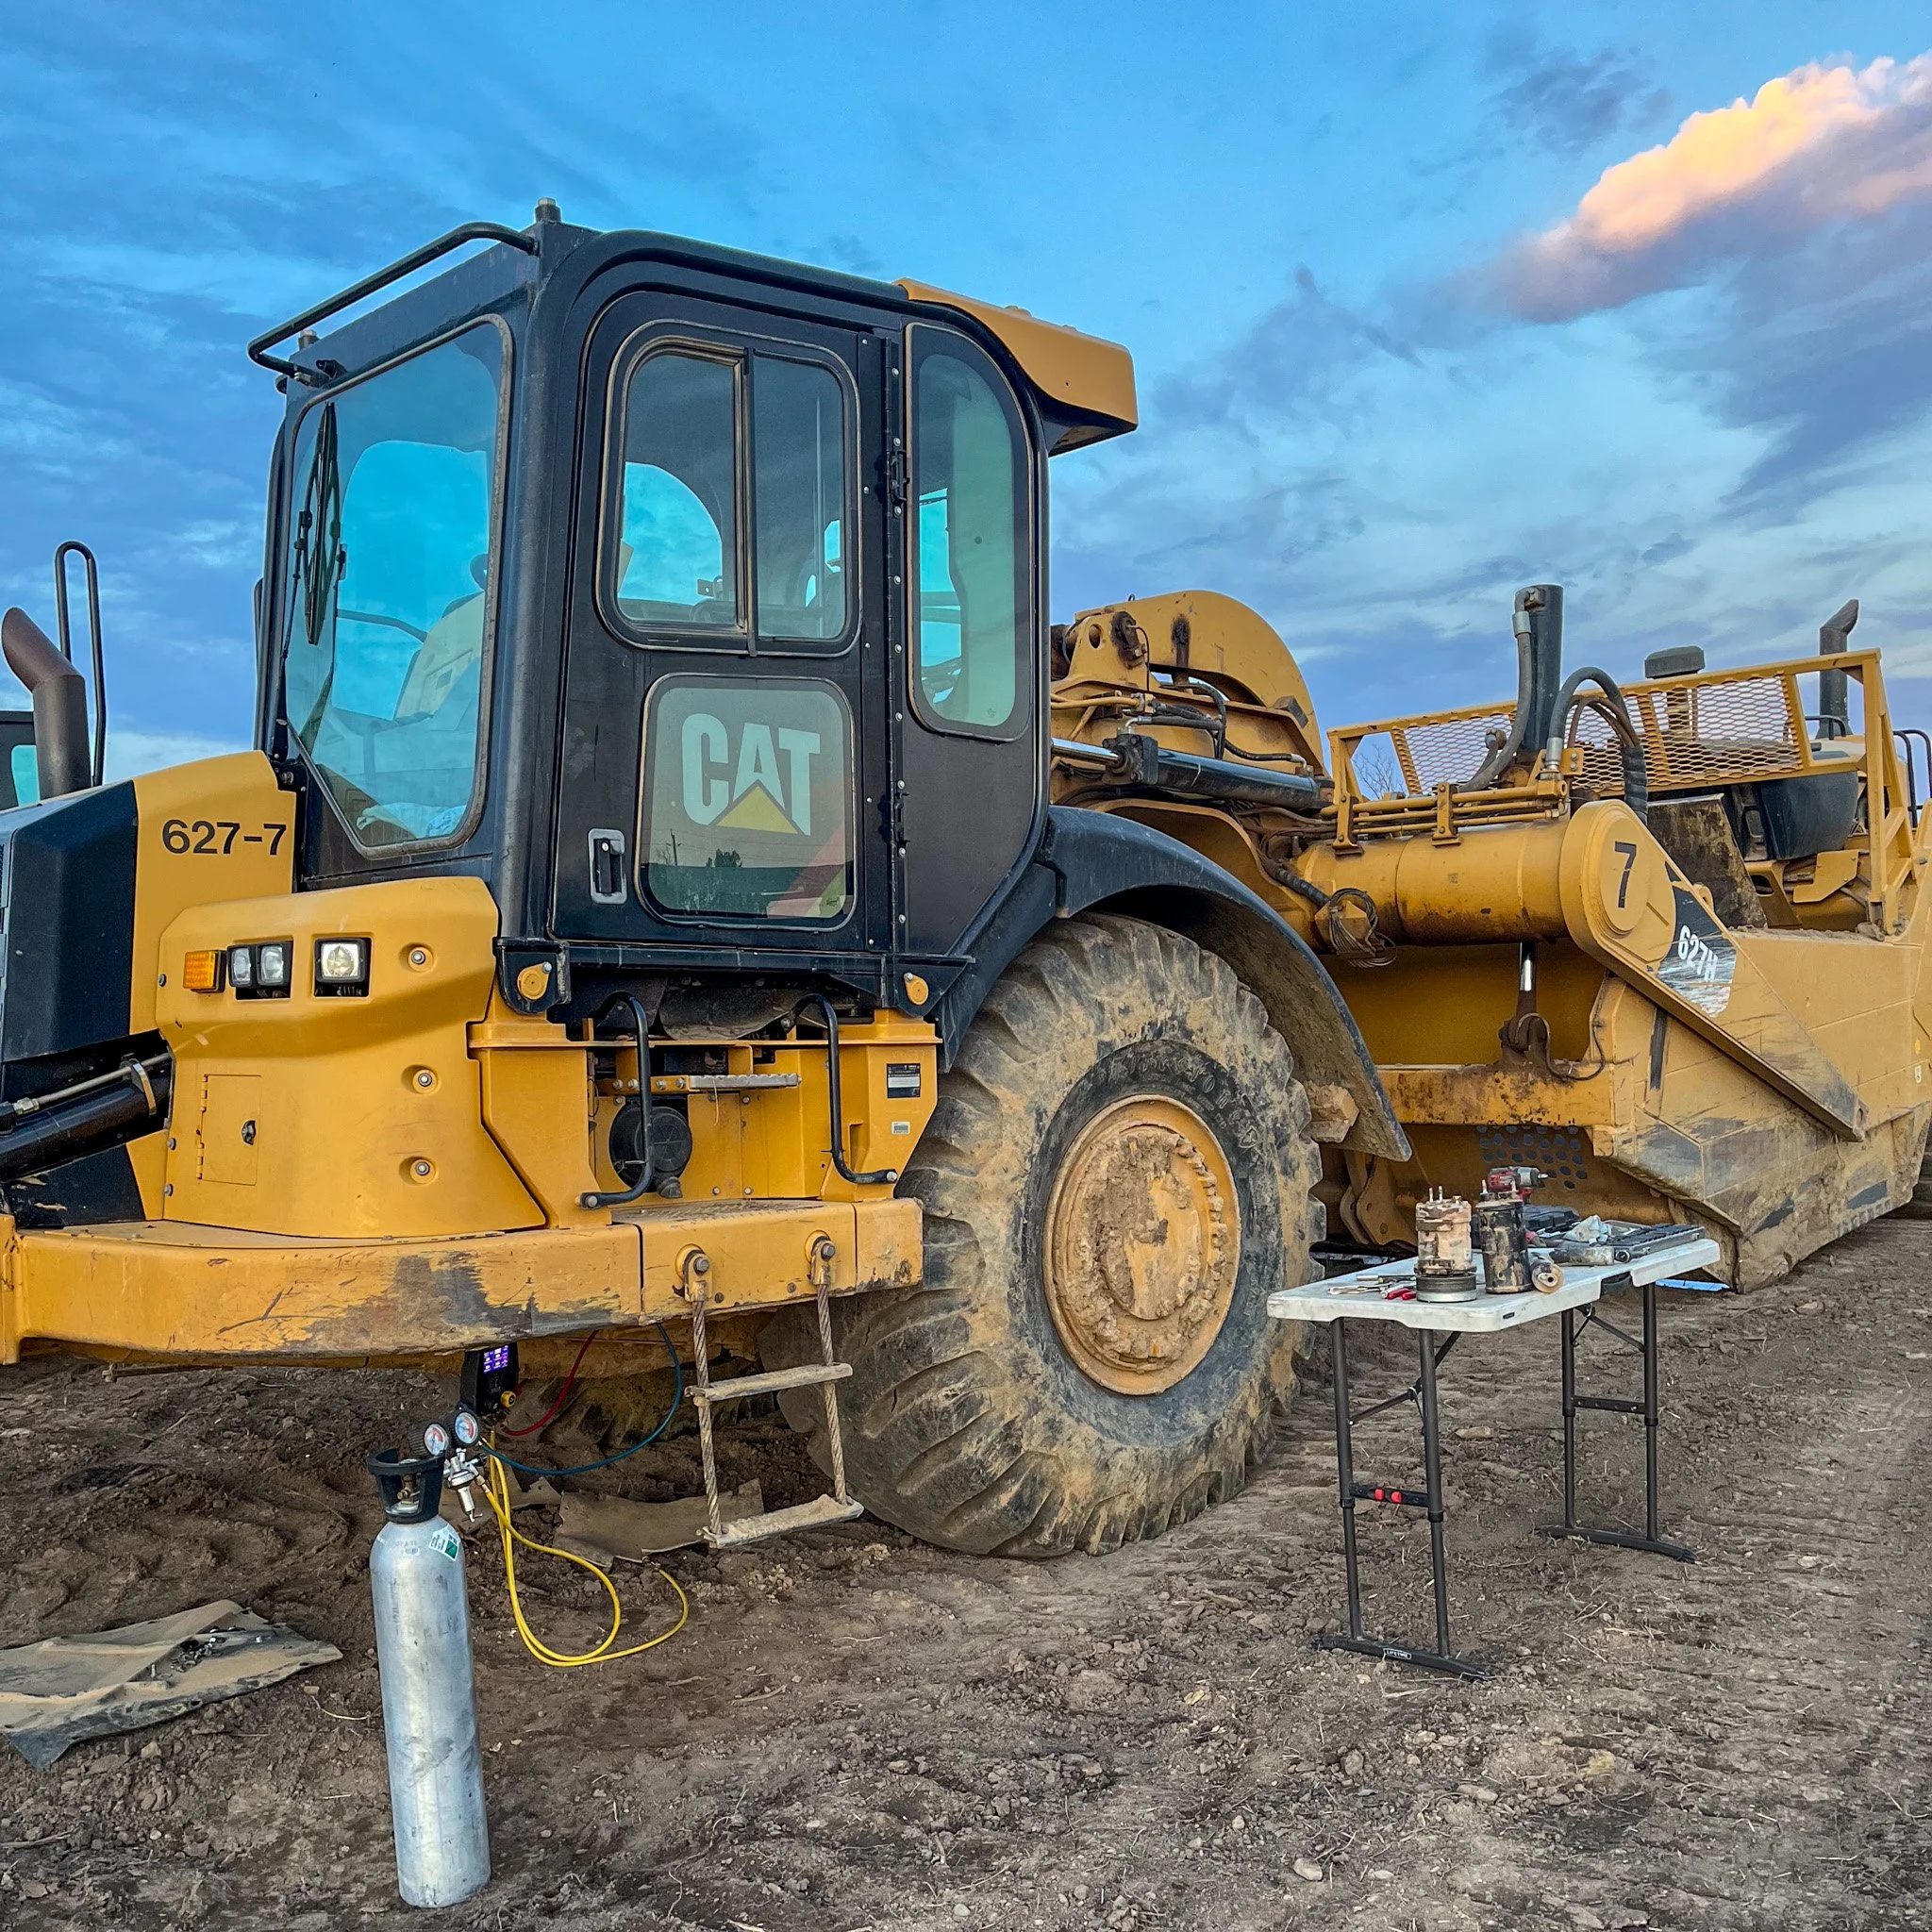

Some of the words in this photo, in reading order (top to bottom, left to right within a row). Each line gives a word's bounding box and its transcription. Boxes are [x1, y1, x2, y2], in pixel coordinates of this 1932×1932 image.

[681, 713, 821, 837] CAT
[161, 819, 287, 856] 627-7
[1614, 841, 1637, 908] 7
[1677, 924, 1719, 983] 627H
